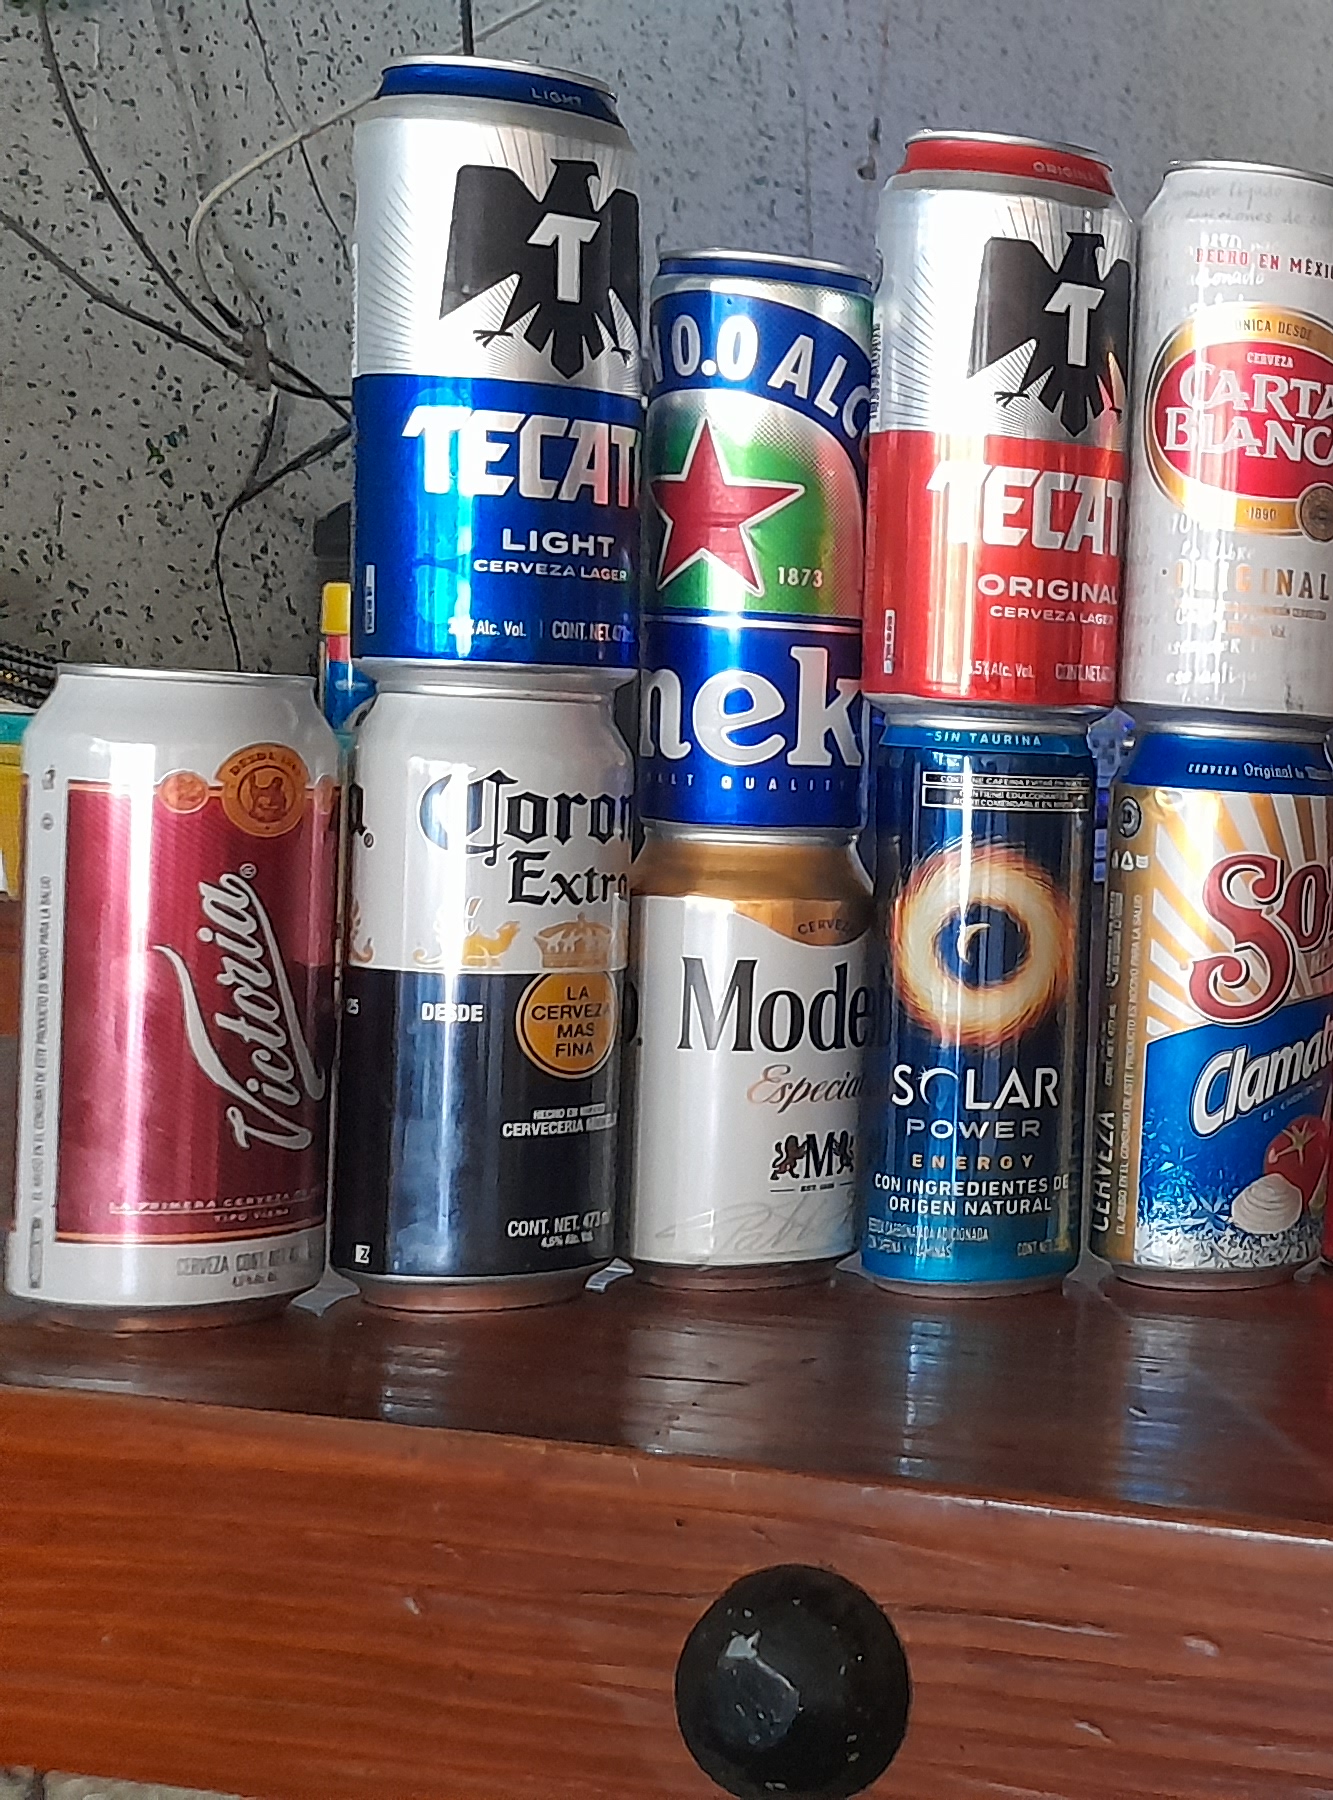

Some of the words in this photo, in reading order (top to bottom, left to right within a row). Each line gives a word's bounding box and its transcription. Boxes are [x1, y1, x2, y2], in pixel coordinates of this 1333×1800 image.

[530, 86, 583, 107] LIGHT
[1259, 252, 1280, 271] EN
[671, 314, 759, 382] 0.0
[1246, 352, 1294, 369] CERVEZA
[401, 405, 642, 509] TECAT
[1247, 505, 1277, 521] 1890
[502, 528, 615, 558] LIGHT
[473, 558, 576, 577] CERVEZA
[580, 566, 629, 582] LAGER
[777, 567, 824, 589] 1873
[977, 573, 1119, 605] ORIGINAL
[989, 605, 1077, 624] CERVEZA
[504, 620, 527, 637] Vol.
[933, 731, 960, 742] SIN
[969, 732, 1043, 747] TAURINA
[1188, 764, 1239, 777] CERVEZA
[1243, 762, 1294, 780] Original
[567, 986, 589, 1001] LA
[153, 872, 325, 1153] Victoria
[421, 1001, 485, 1023] DESDE
[557, 1021, 595, 1039] MAS
[555, 1040, 595, 1058] FINA
[891, 1063, 1061, 1110] SOLAR
[502, 1119, 584, 1137] CERVECERIA
[906, 1117, 1041, 1140] POWER
[911, 1153, 1036, 1171] ENERGY
[1092, 1111, 1115, 1232] CERVEZA
[874, 1173, 901, 1192] CON
[906, 1176, 1049, 1197] INGREDIENTES
[1053, 1173, 1070, 1191] DE
[137, 1199, 217, 1212] PRIMERA
[888, 1195, 956, 1216] ORIGEN
[964, 1197, 1053, 1217] NATURAL
[507, 1217, 550, 1238] CONT.
[554, 1215, 581, 1233] NET.
